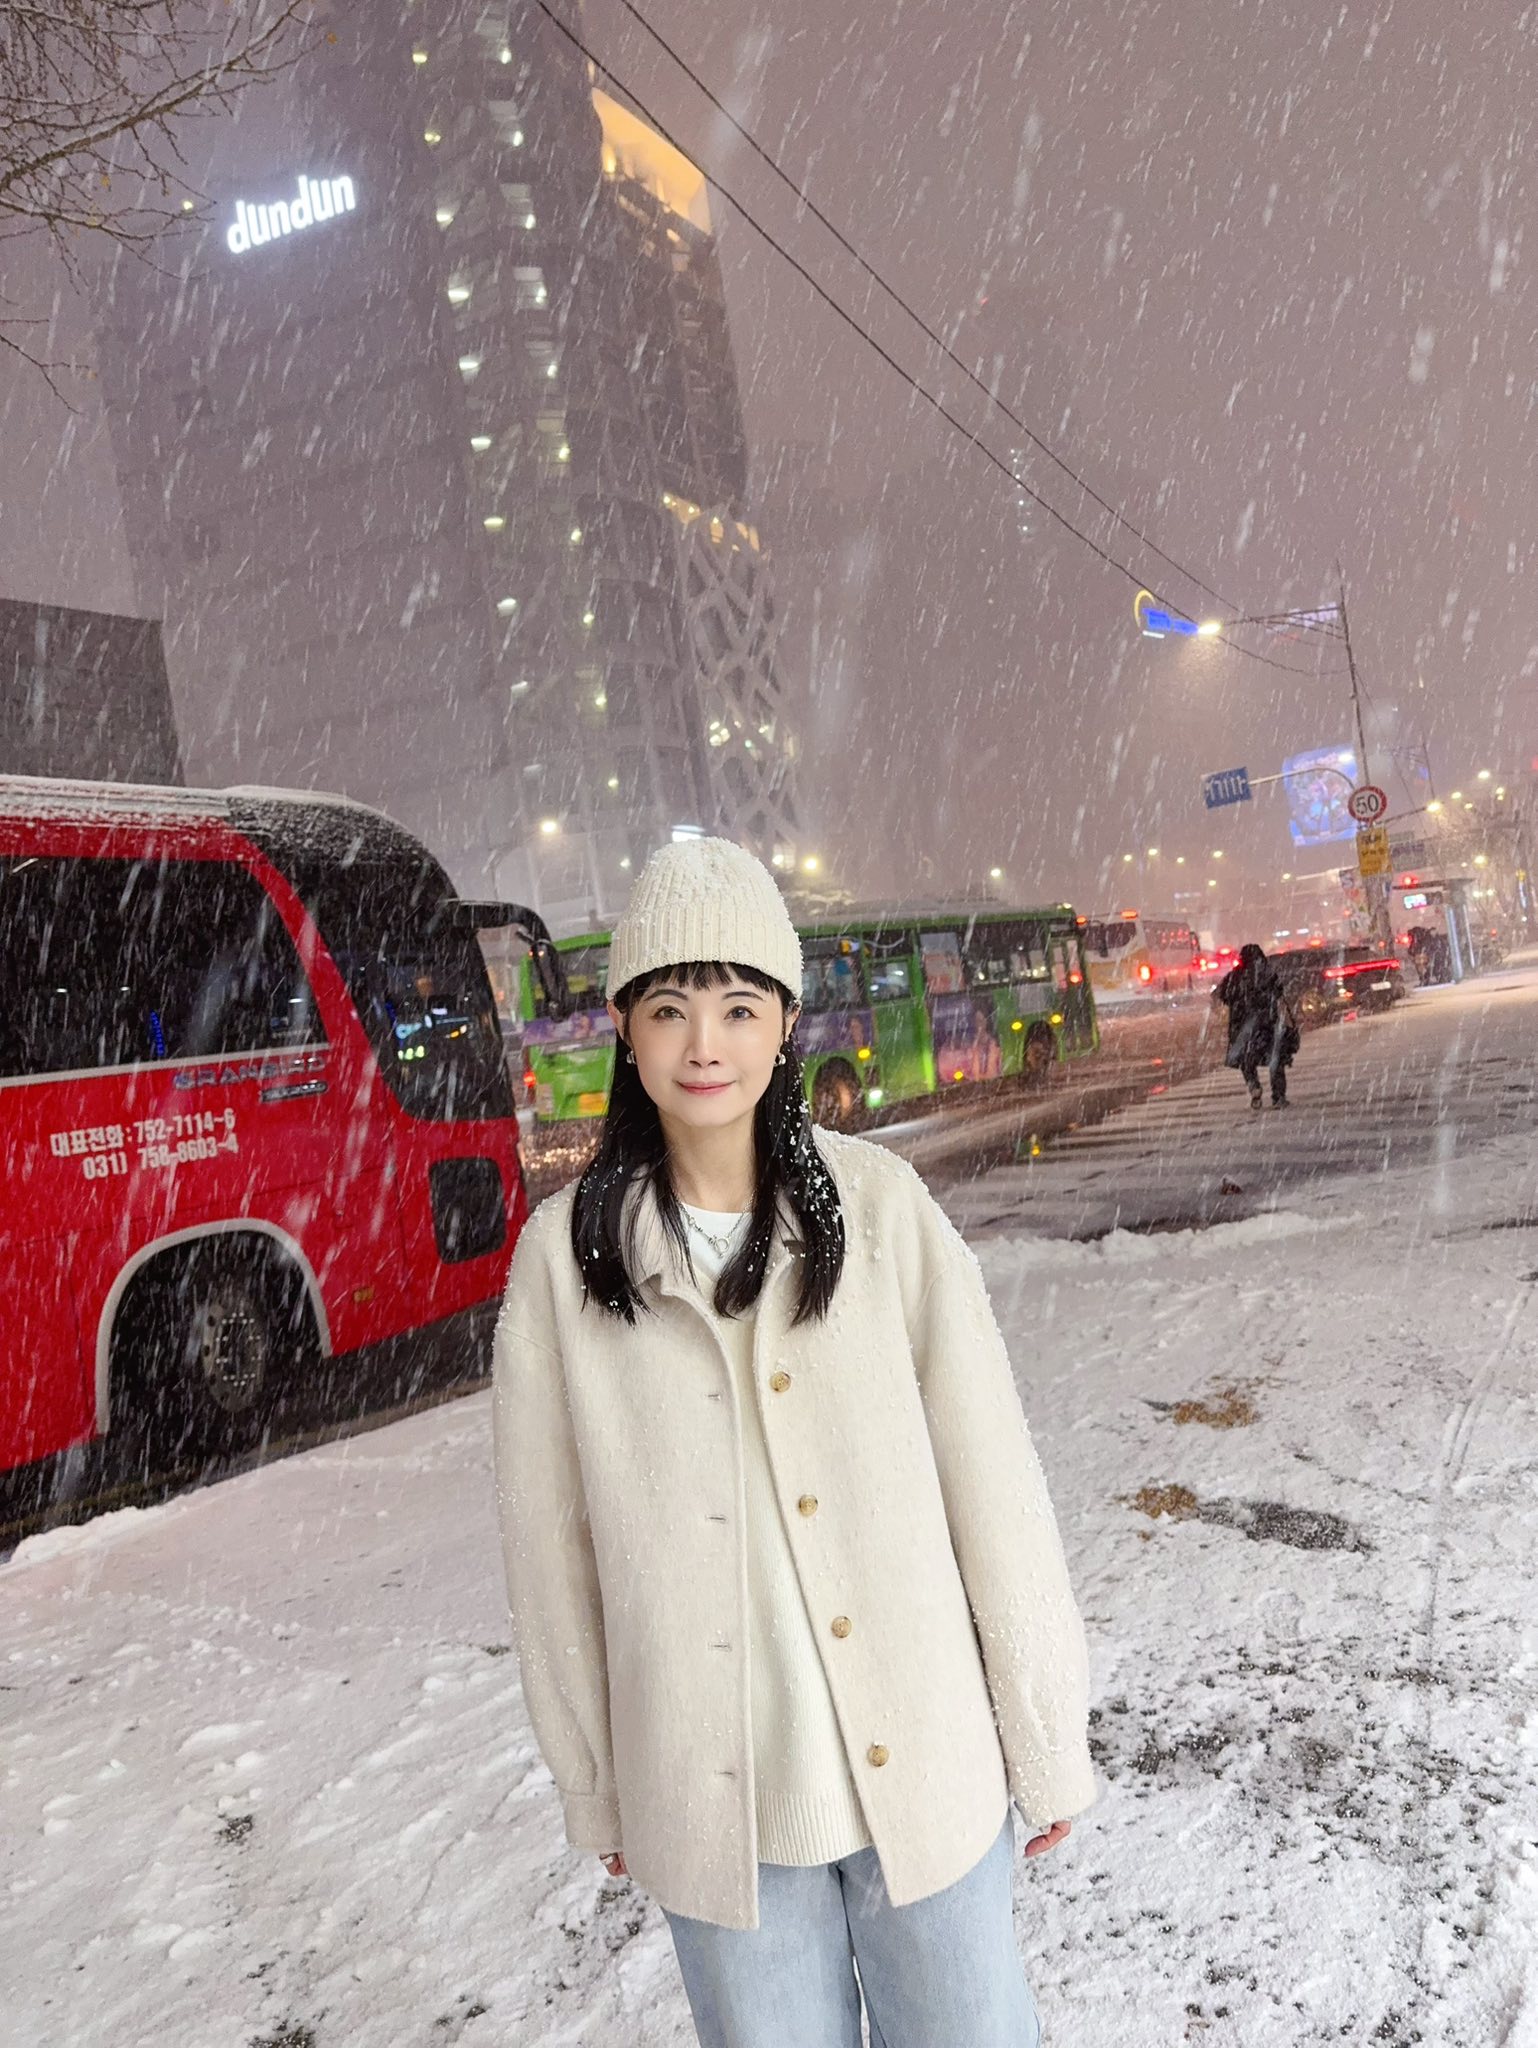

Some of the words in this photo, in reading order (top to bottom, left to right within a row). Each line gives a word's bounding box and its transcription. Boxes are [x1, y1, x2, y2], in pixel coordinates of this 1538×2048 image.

[227, 174, 357, 254] dundun
[1356, 793, 1379, 815] 50
[82, 1151, 128, 1180] 031)
